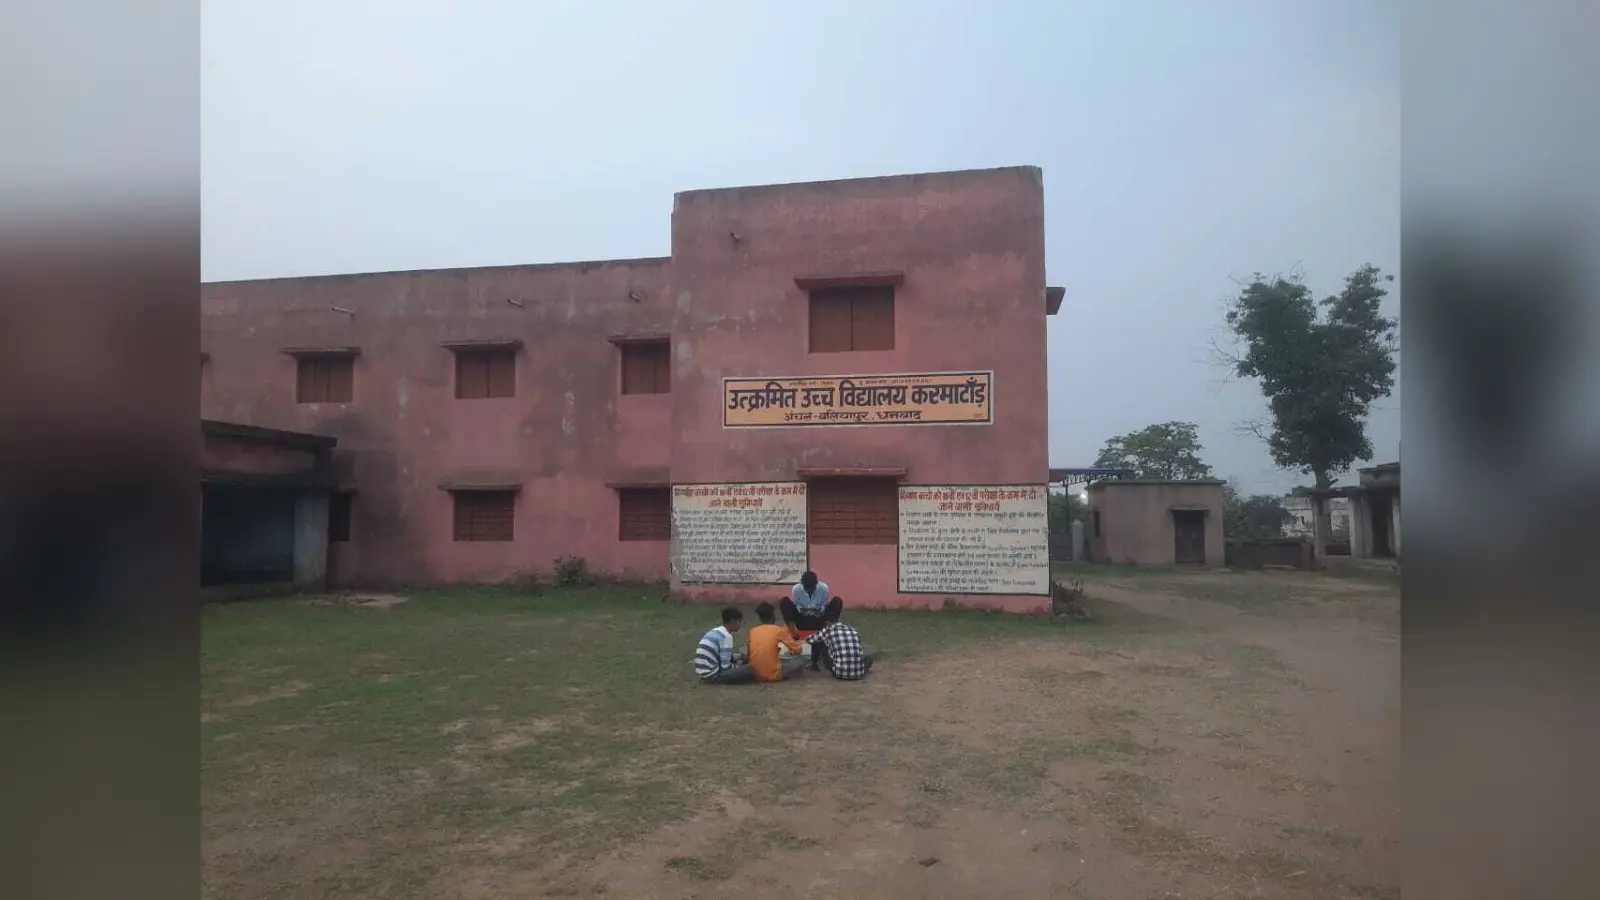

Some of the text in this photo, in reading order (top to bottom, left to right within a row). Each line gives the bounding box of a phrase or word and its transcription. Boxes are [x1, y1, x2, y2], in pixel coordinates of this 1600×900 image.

[728, 380, 798, 412] उत्क्रमित
[801, 387, 834, 408] उच्च
[839, 380, 908, 408] विद्यालय
